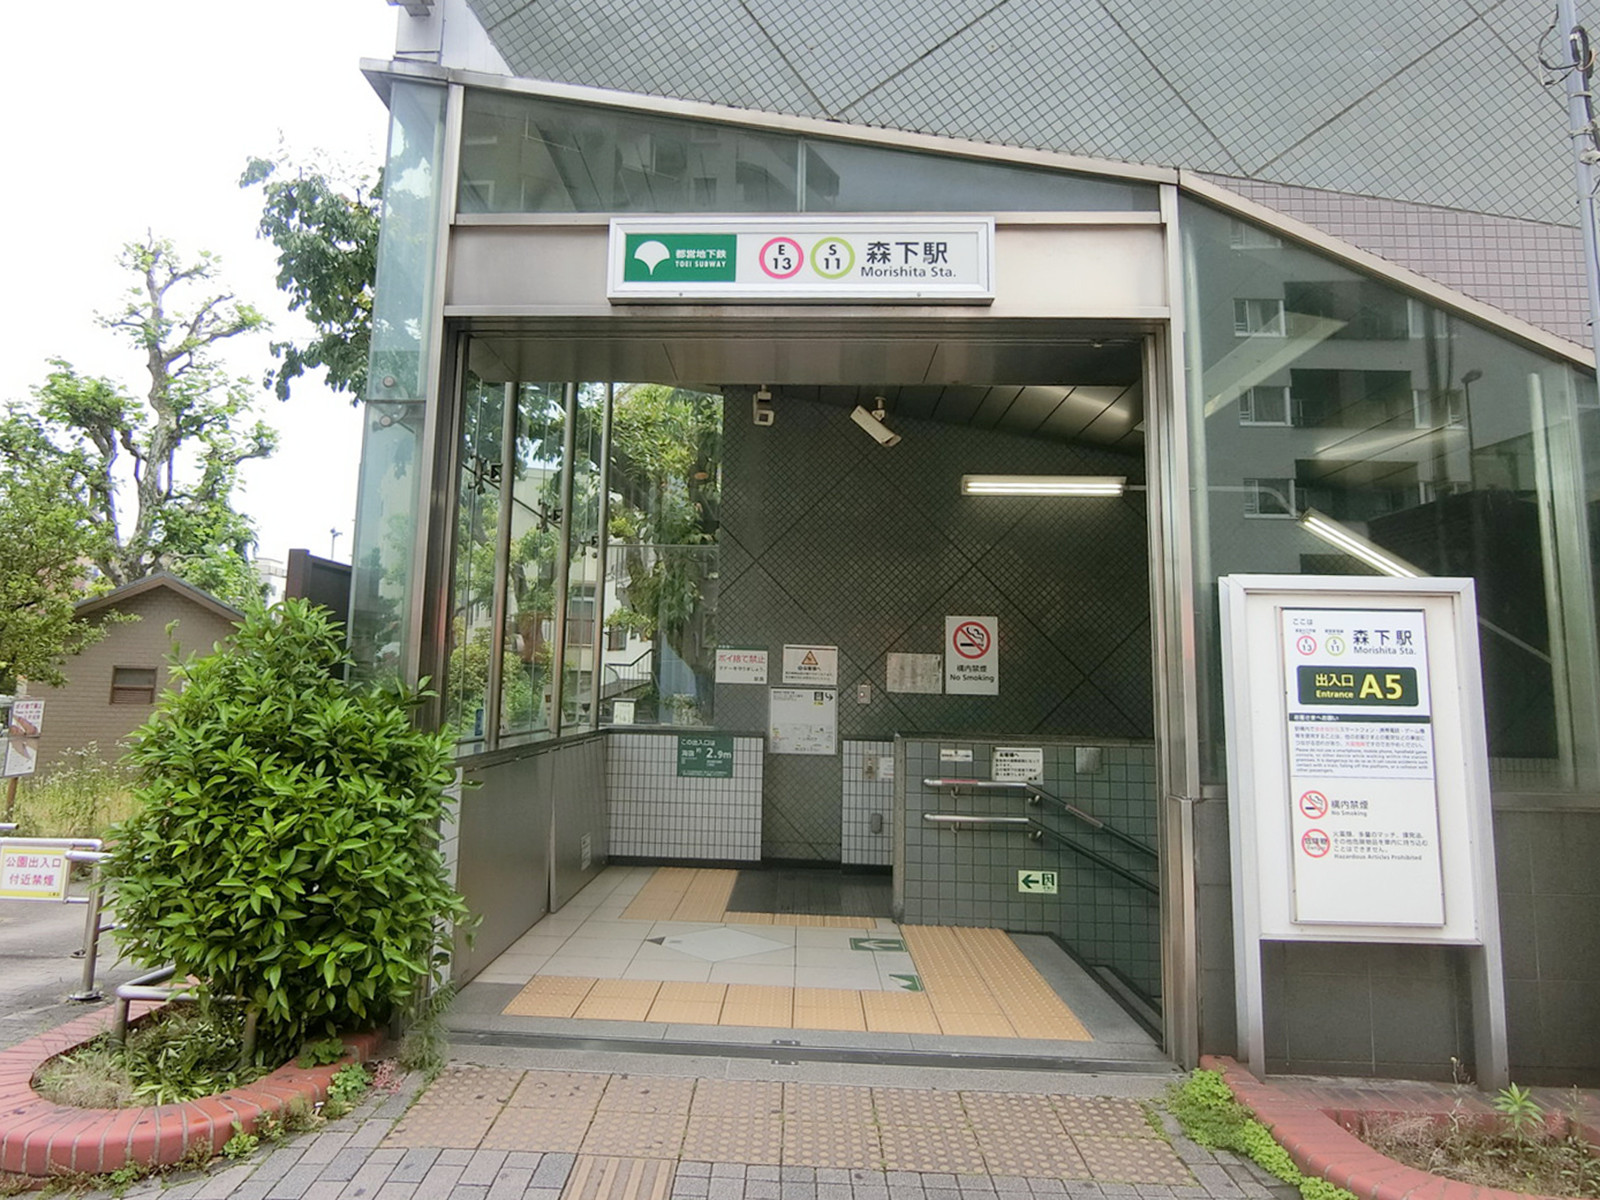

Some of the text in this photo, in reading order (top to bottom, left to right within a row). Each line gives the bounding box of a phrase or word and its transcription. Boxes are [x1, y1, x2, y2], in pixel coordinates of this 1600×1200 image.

[676, 249, 727, 259] 都営地下鉄
[778, 244, 786, 256] E
[828, 244, 837, 256] S
[866, 241, 948, 266] 森下駅
[675, 260, 727, 268] TOEI SUBWAY
[772, 258, 792, 270] 13
[824, 258, 841, 270] 11
[860, 265, 957, 278] Morishita Sta.
[1292, 618, 1314, 626] ここは
[1353, 630, 1412, 646] 森下駅
[1302, 644, 1312, 652] 13
[1354, 646, 1416, 655] Morishita Sta.
[718, 655, 765, 664] ポイ捨て禁止
[957, 665, 987, 673] 構内禁煙
[963, 674, 994, 683] Smoking
[1316, 673, 1354, 687] 出入口
[1359, 674, 1404, 700] A5
[1316, 690, 1354, 699] Entrance
[706, 748, 732, 759] 2.9m
[1331, 800, 1368, 810] 構内禁煙
[6, 856, 62, 868] 公園出入口
[9, 874, 54, 886] 付近禁煙
